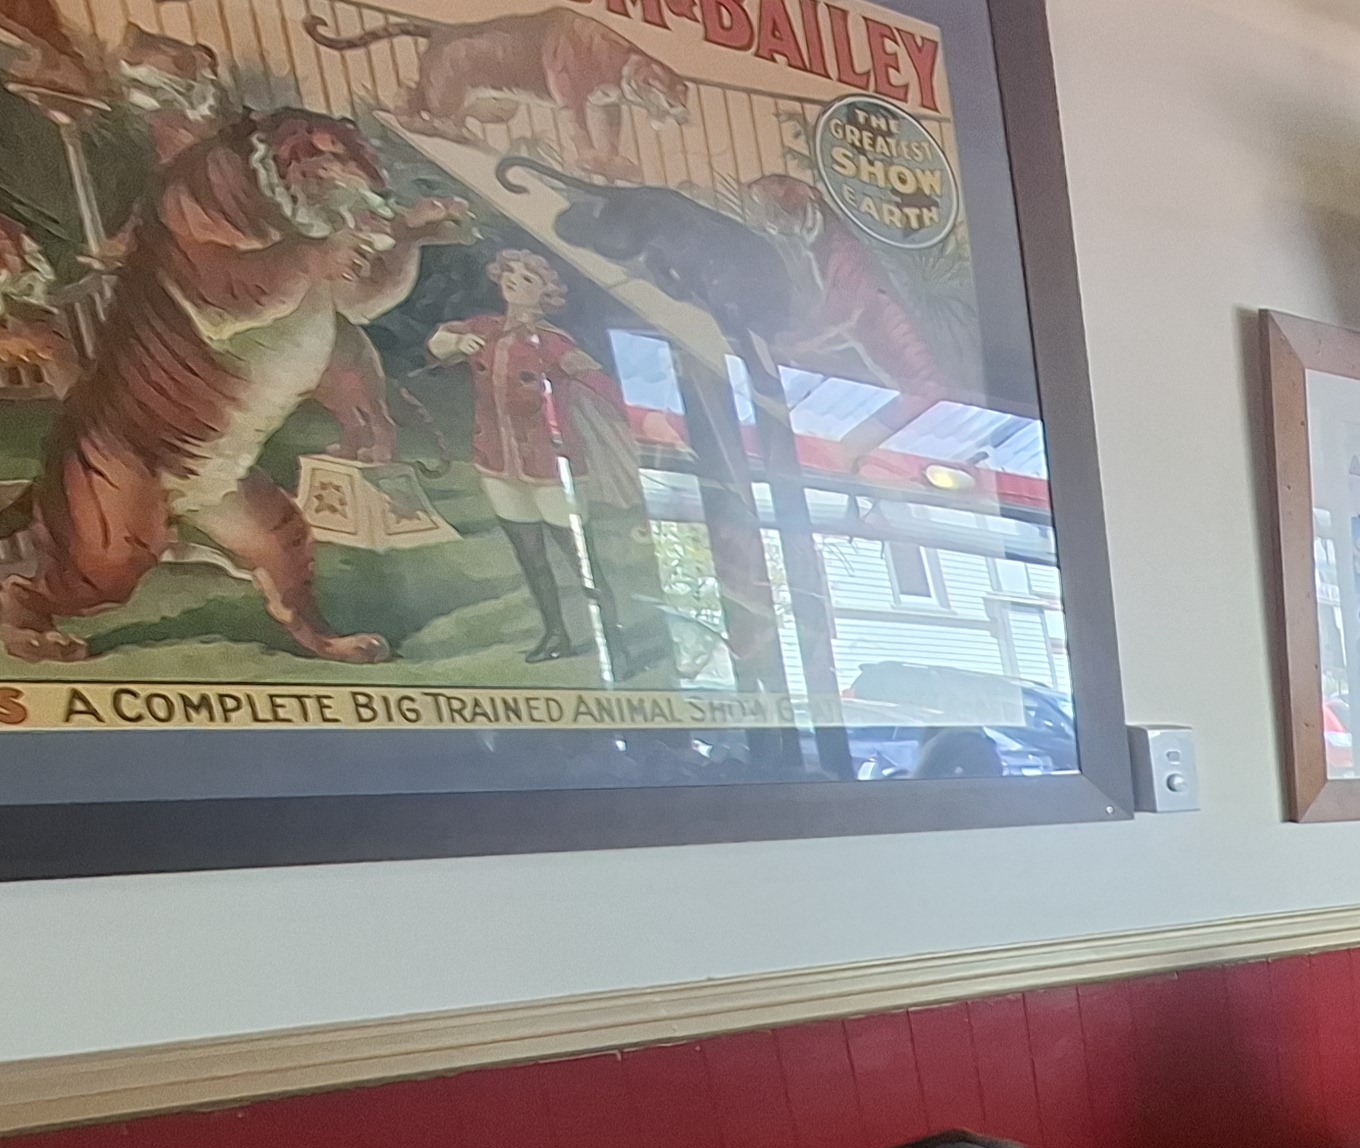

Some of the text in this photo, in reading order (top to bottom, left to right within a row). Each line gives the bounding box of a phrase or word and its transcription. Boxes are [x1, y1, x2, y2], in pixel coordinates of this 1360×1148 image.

[701, 0, 940, 113] BAILEY
[829, 119, 933, 162] GREATEST
[854, 108, 900, 134] THE
[830, 146, 942, 197] SHOW
[842, 184, 940, 231] EARTH
[64, 687, 106, 724] A
[111, 687, 342, 724] COMPLETE
[350, 690, 420, 724] BIG
[421, 691, 563, 724] TRAINED
[572, 694, 682, 725] ANIMAL
